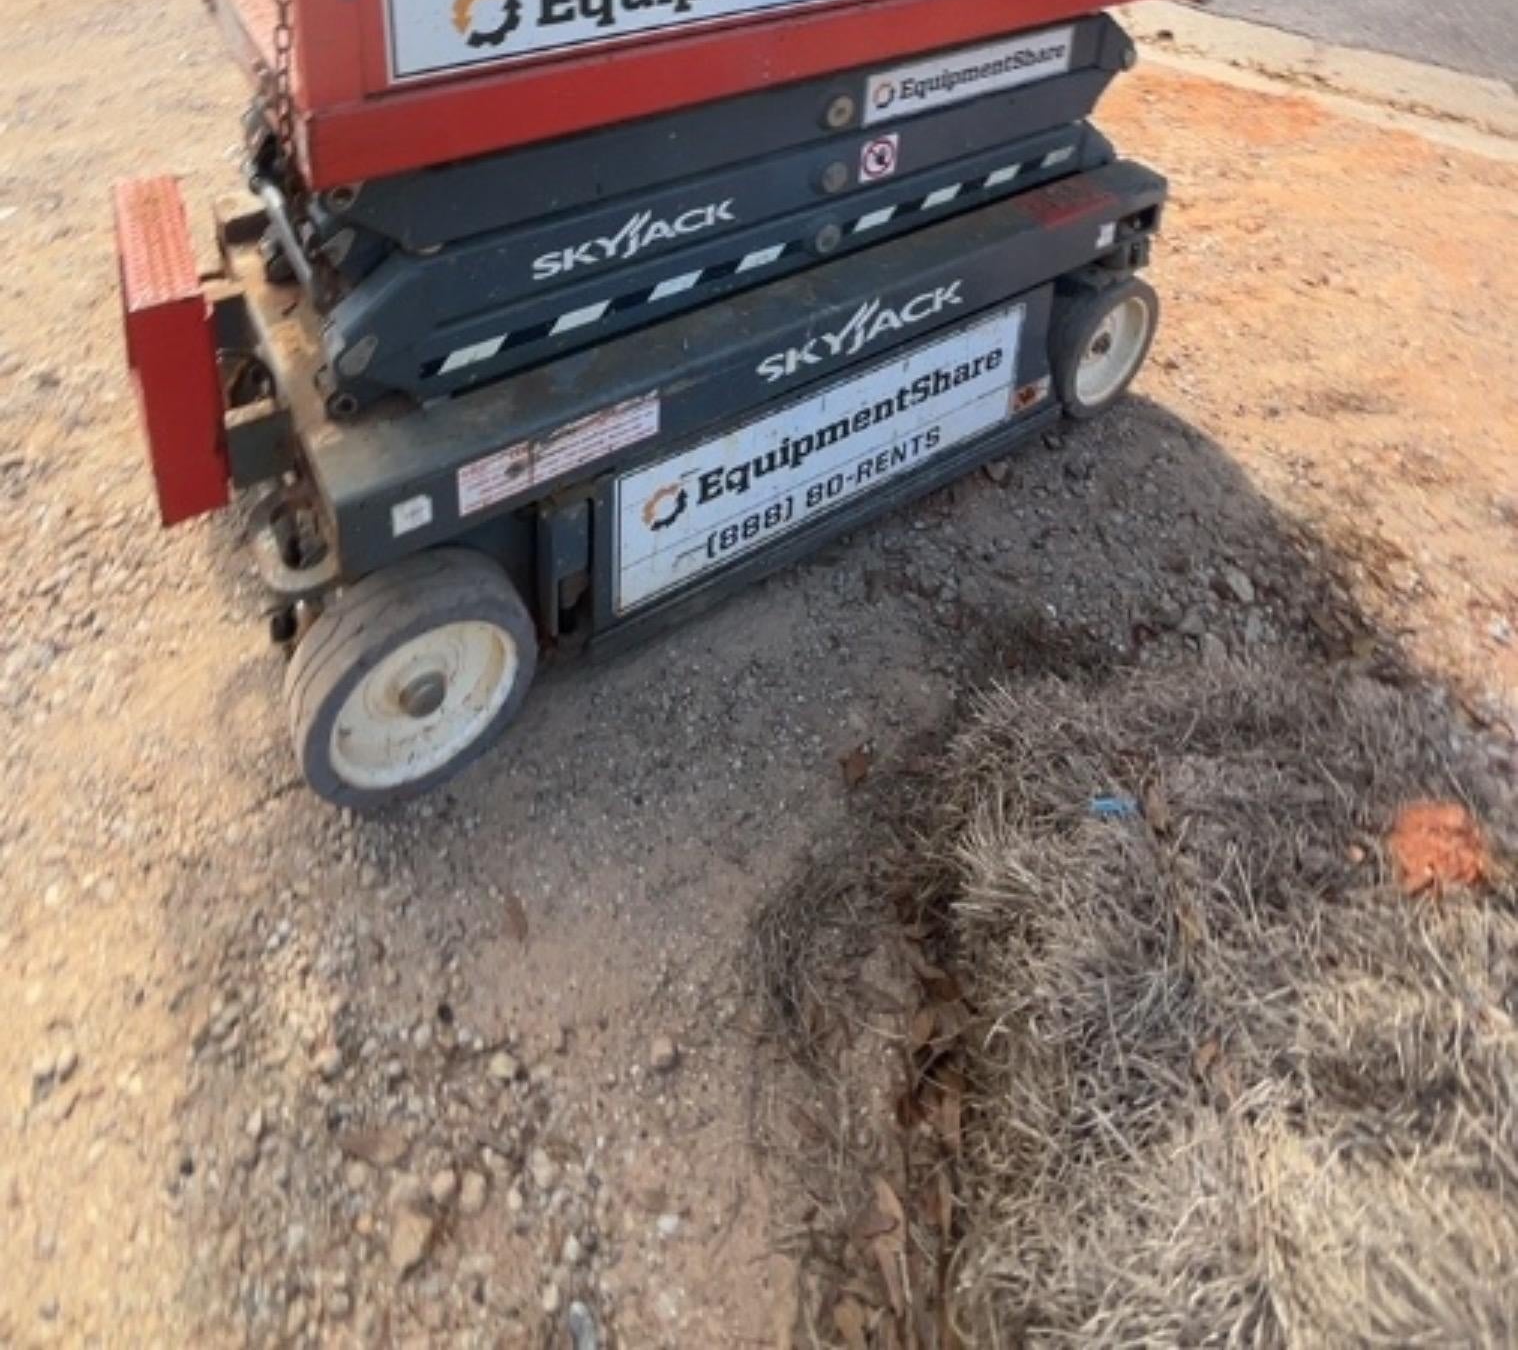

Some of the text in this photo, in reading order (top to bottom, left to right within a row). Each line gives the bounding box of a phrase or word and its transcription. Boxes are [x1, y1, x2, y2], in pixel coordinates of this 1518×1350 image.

[900, 44, 1066, 99] EquipmentShare
[532, 198, 735, 280] SKYJACK
[755, 279, 963, 382] SKYJACK
[696, 348, 1002, 507] EquipmentShare
[706, 426, 942, 559] (888) 80-RENTS
